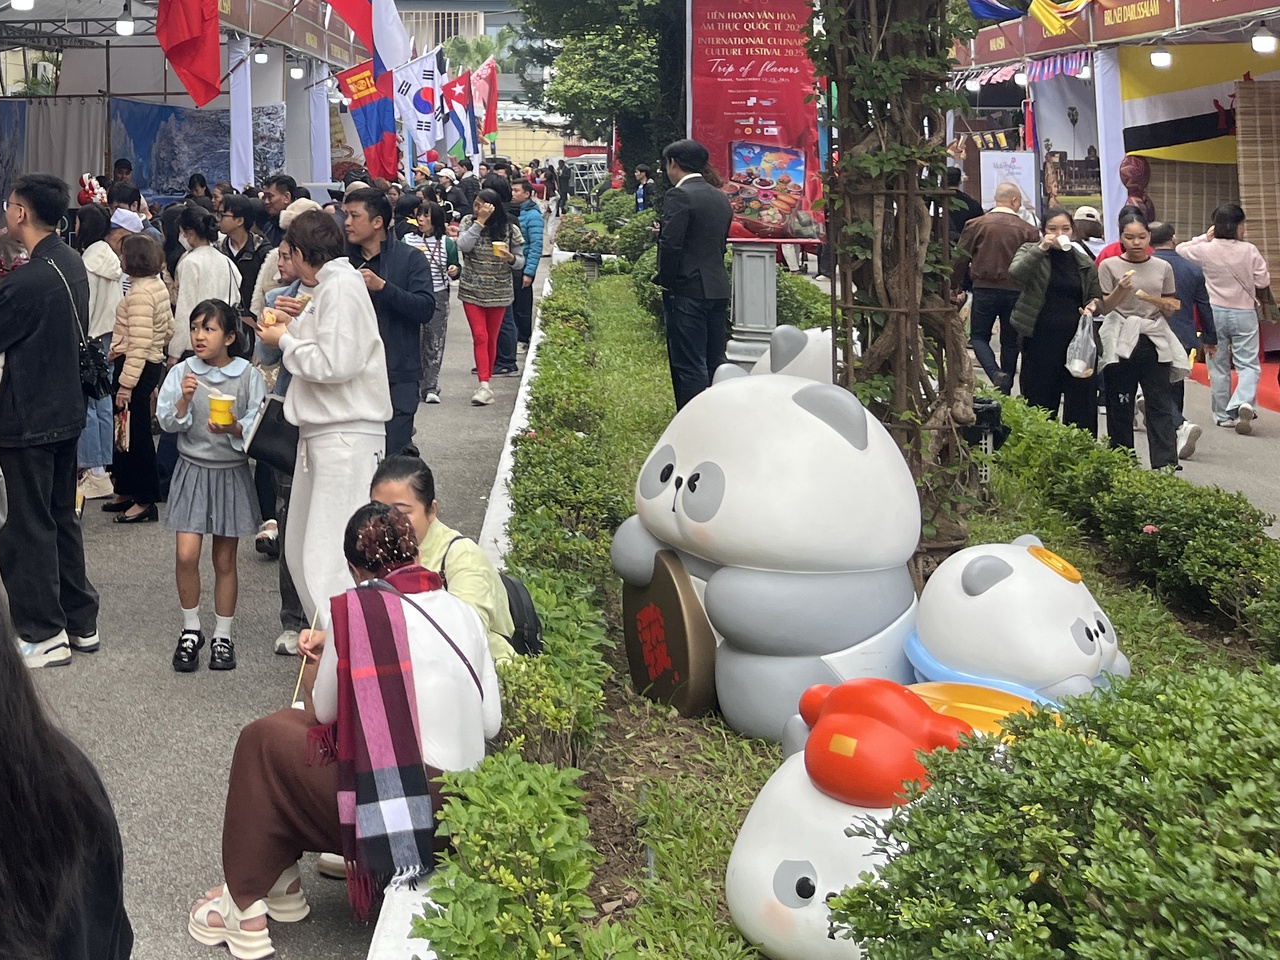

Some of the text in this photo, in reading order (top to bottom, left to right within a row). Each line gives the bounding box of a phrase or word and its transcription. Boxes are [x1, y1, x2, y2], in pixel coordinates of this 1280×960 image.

[727, 11, 755, 20] HOAN
[756, 10, 775, 20] VĂN
[1104, 5, 1123, 26] BRUNEI
[716, 22, 741, 32] THỤC
[743, 20, 771, 32] QUỐC
[697, 37, 765, 46] INTERNATIONAL
[705, 48, 804, 57] CULTURE FESTIVAL 2025
[707, 58, 800, 78] Trip of flavors
